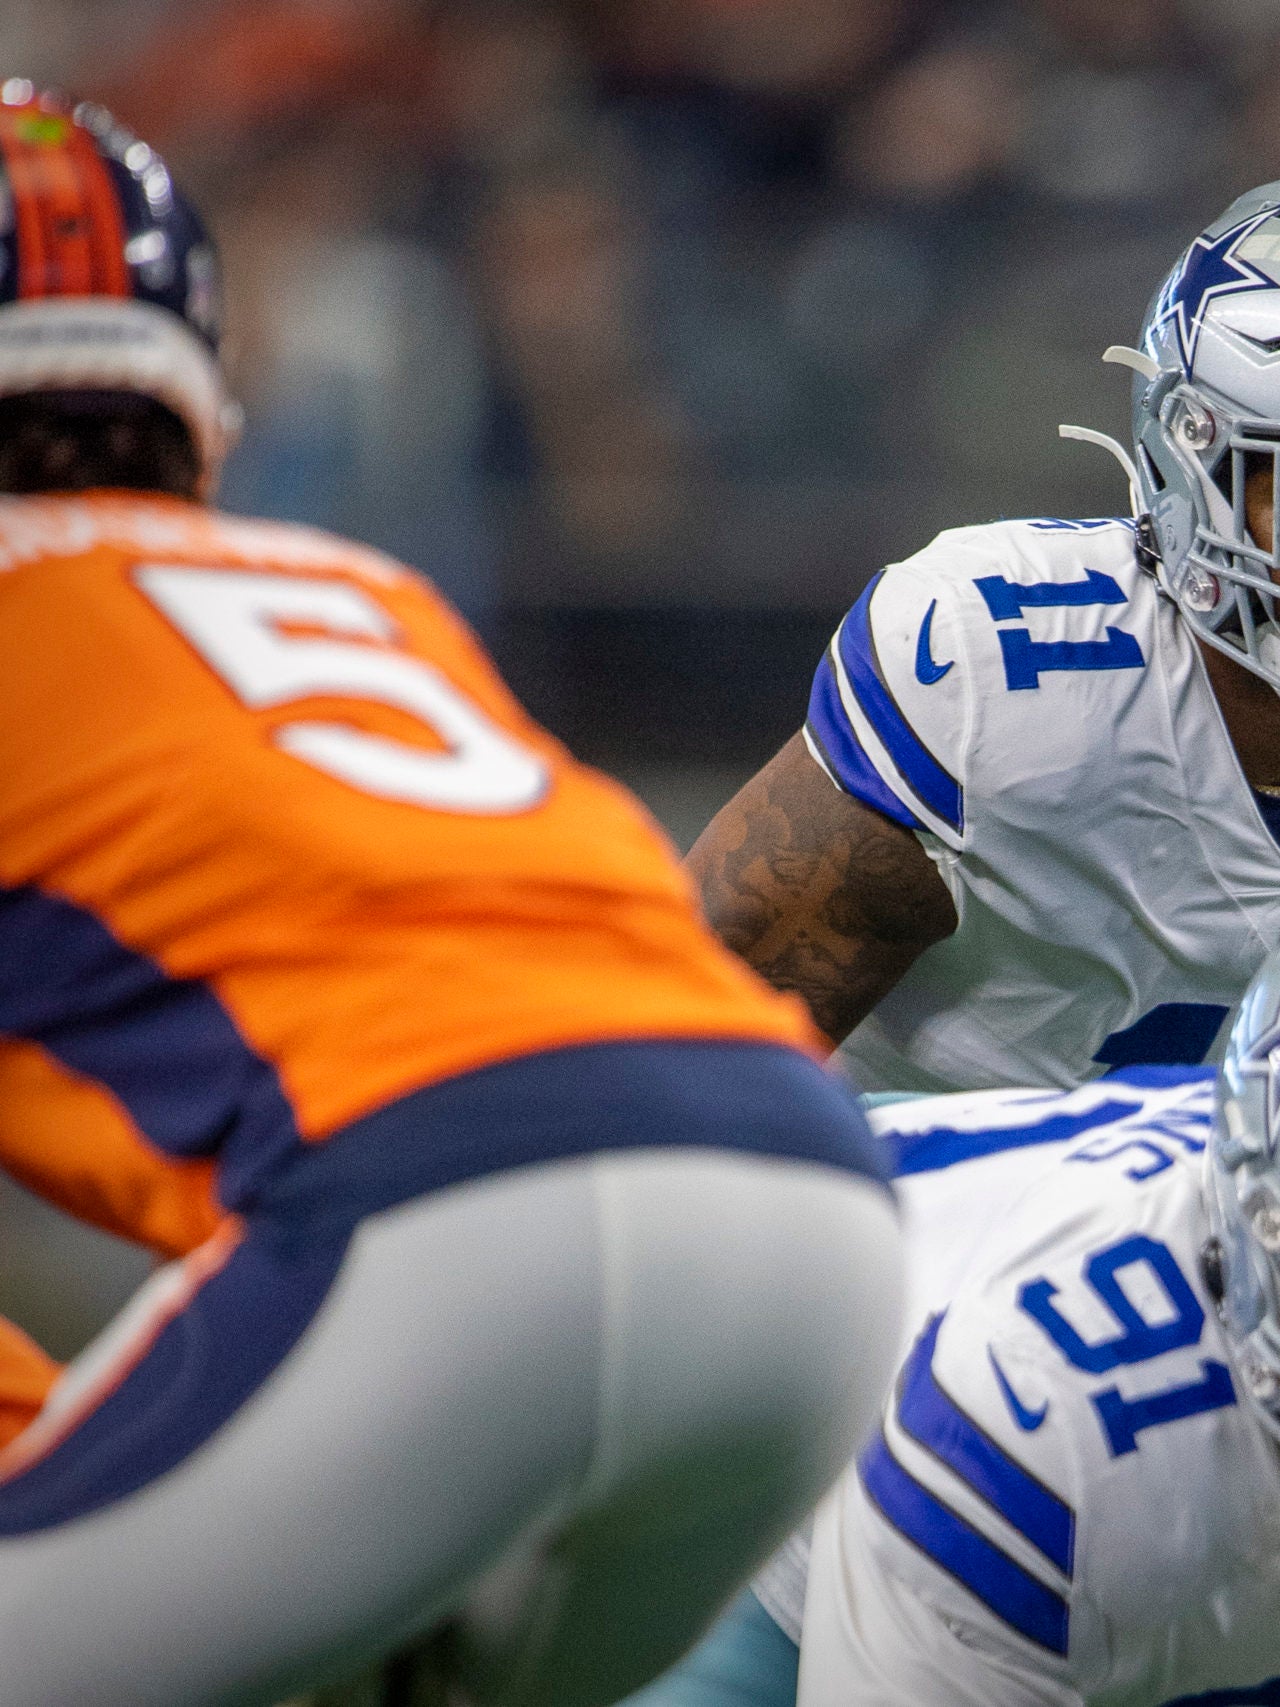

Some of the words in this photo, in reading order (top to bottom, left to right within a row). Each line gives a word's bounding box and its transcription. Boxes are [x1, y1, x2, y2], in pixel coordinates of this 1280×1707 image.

[132, 563, 550, 813] 5
[972, 567, 1146, 691] 11
[1015, 1231, 1237, 1460] 91
